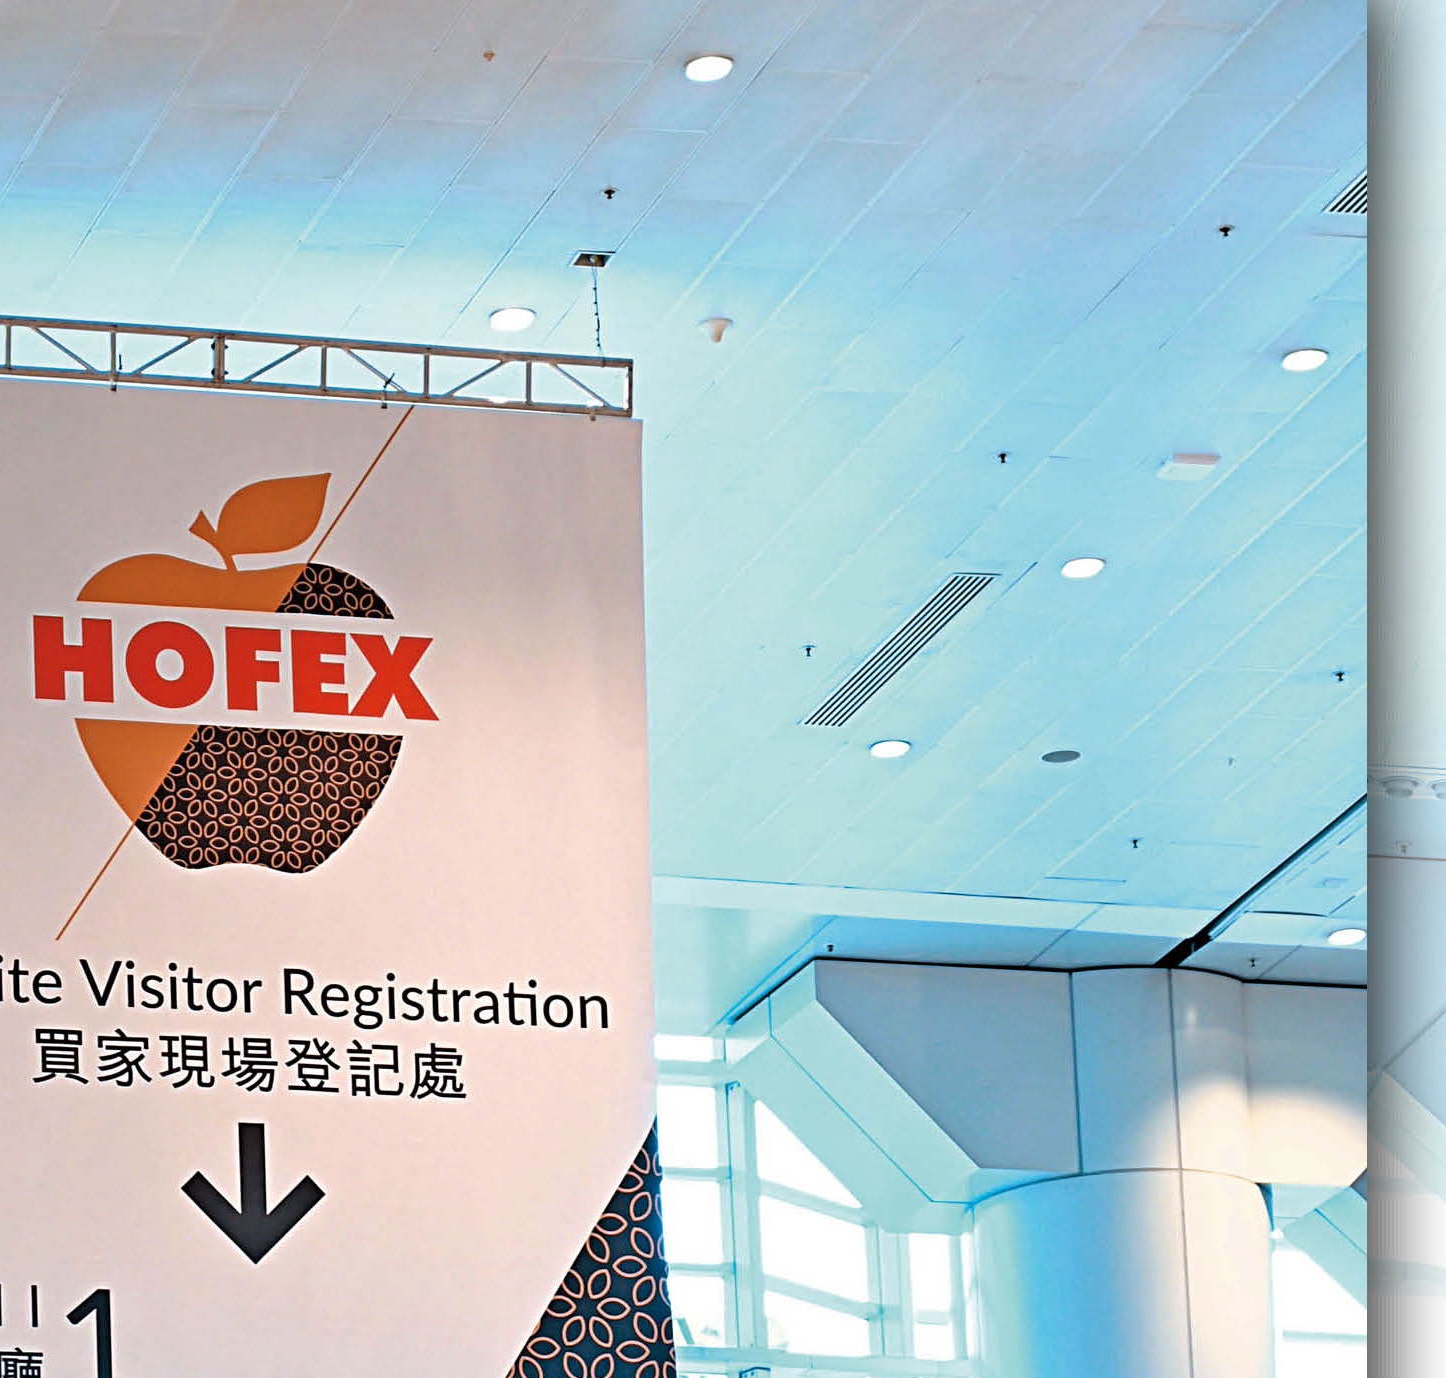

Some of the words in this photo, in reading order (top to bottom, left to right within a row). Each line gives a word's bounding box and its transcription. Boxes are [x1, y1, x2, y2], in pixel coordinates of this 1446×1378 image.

[33, 615, 439, 721] HOFEX
[79, 958, 263, 1014] Visitor
[283, 968, 610, 1030] Registration
[32, 1027, 467, 1100] 買家現場登記處
